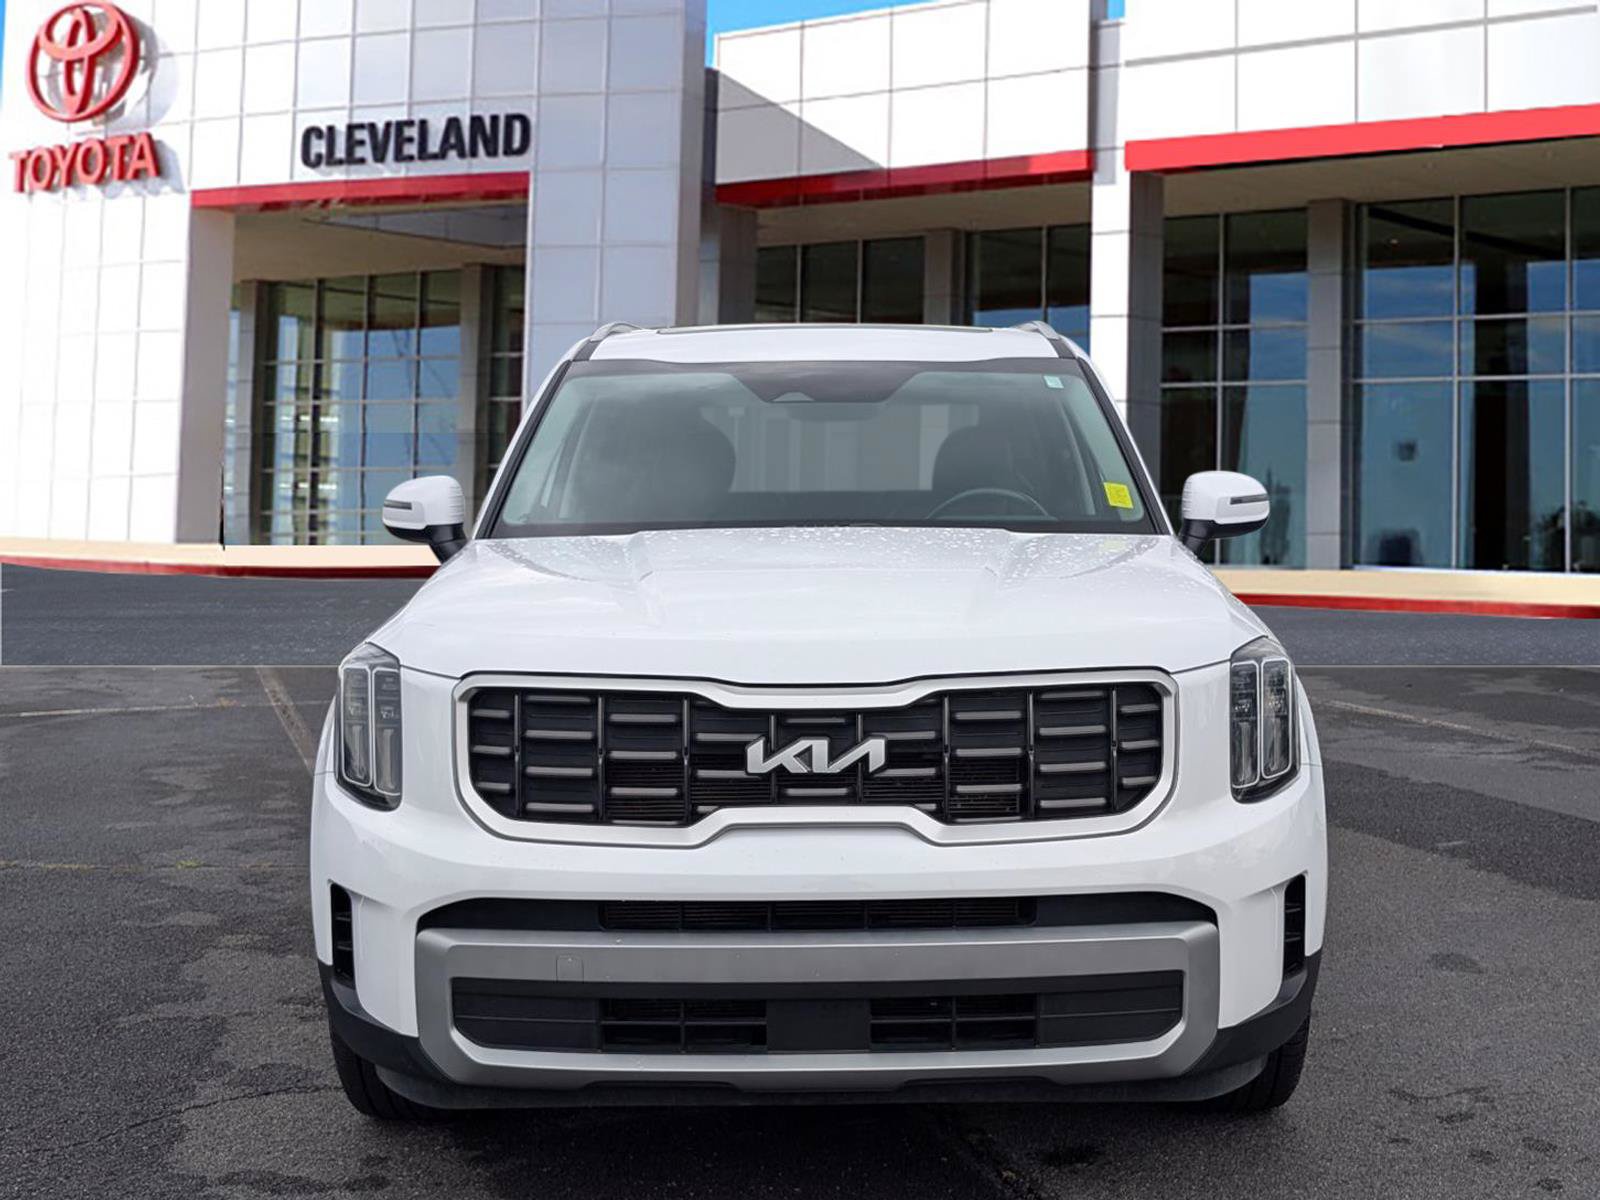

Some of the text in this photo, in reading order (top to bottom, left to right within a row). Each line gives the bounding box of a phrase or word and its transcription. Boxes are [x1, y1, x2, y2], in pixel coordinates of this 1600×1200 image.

[9, 132, 161, 193] TOYOTA
[301, 113, 531, 169] CLEVELAND
[746, 737, 887, 774] KIA
